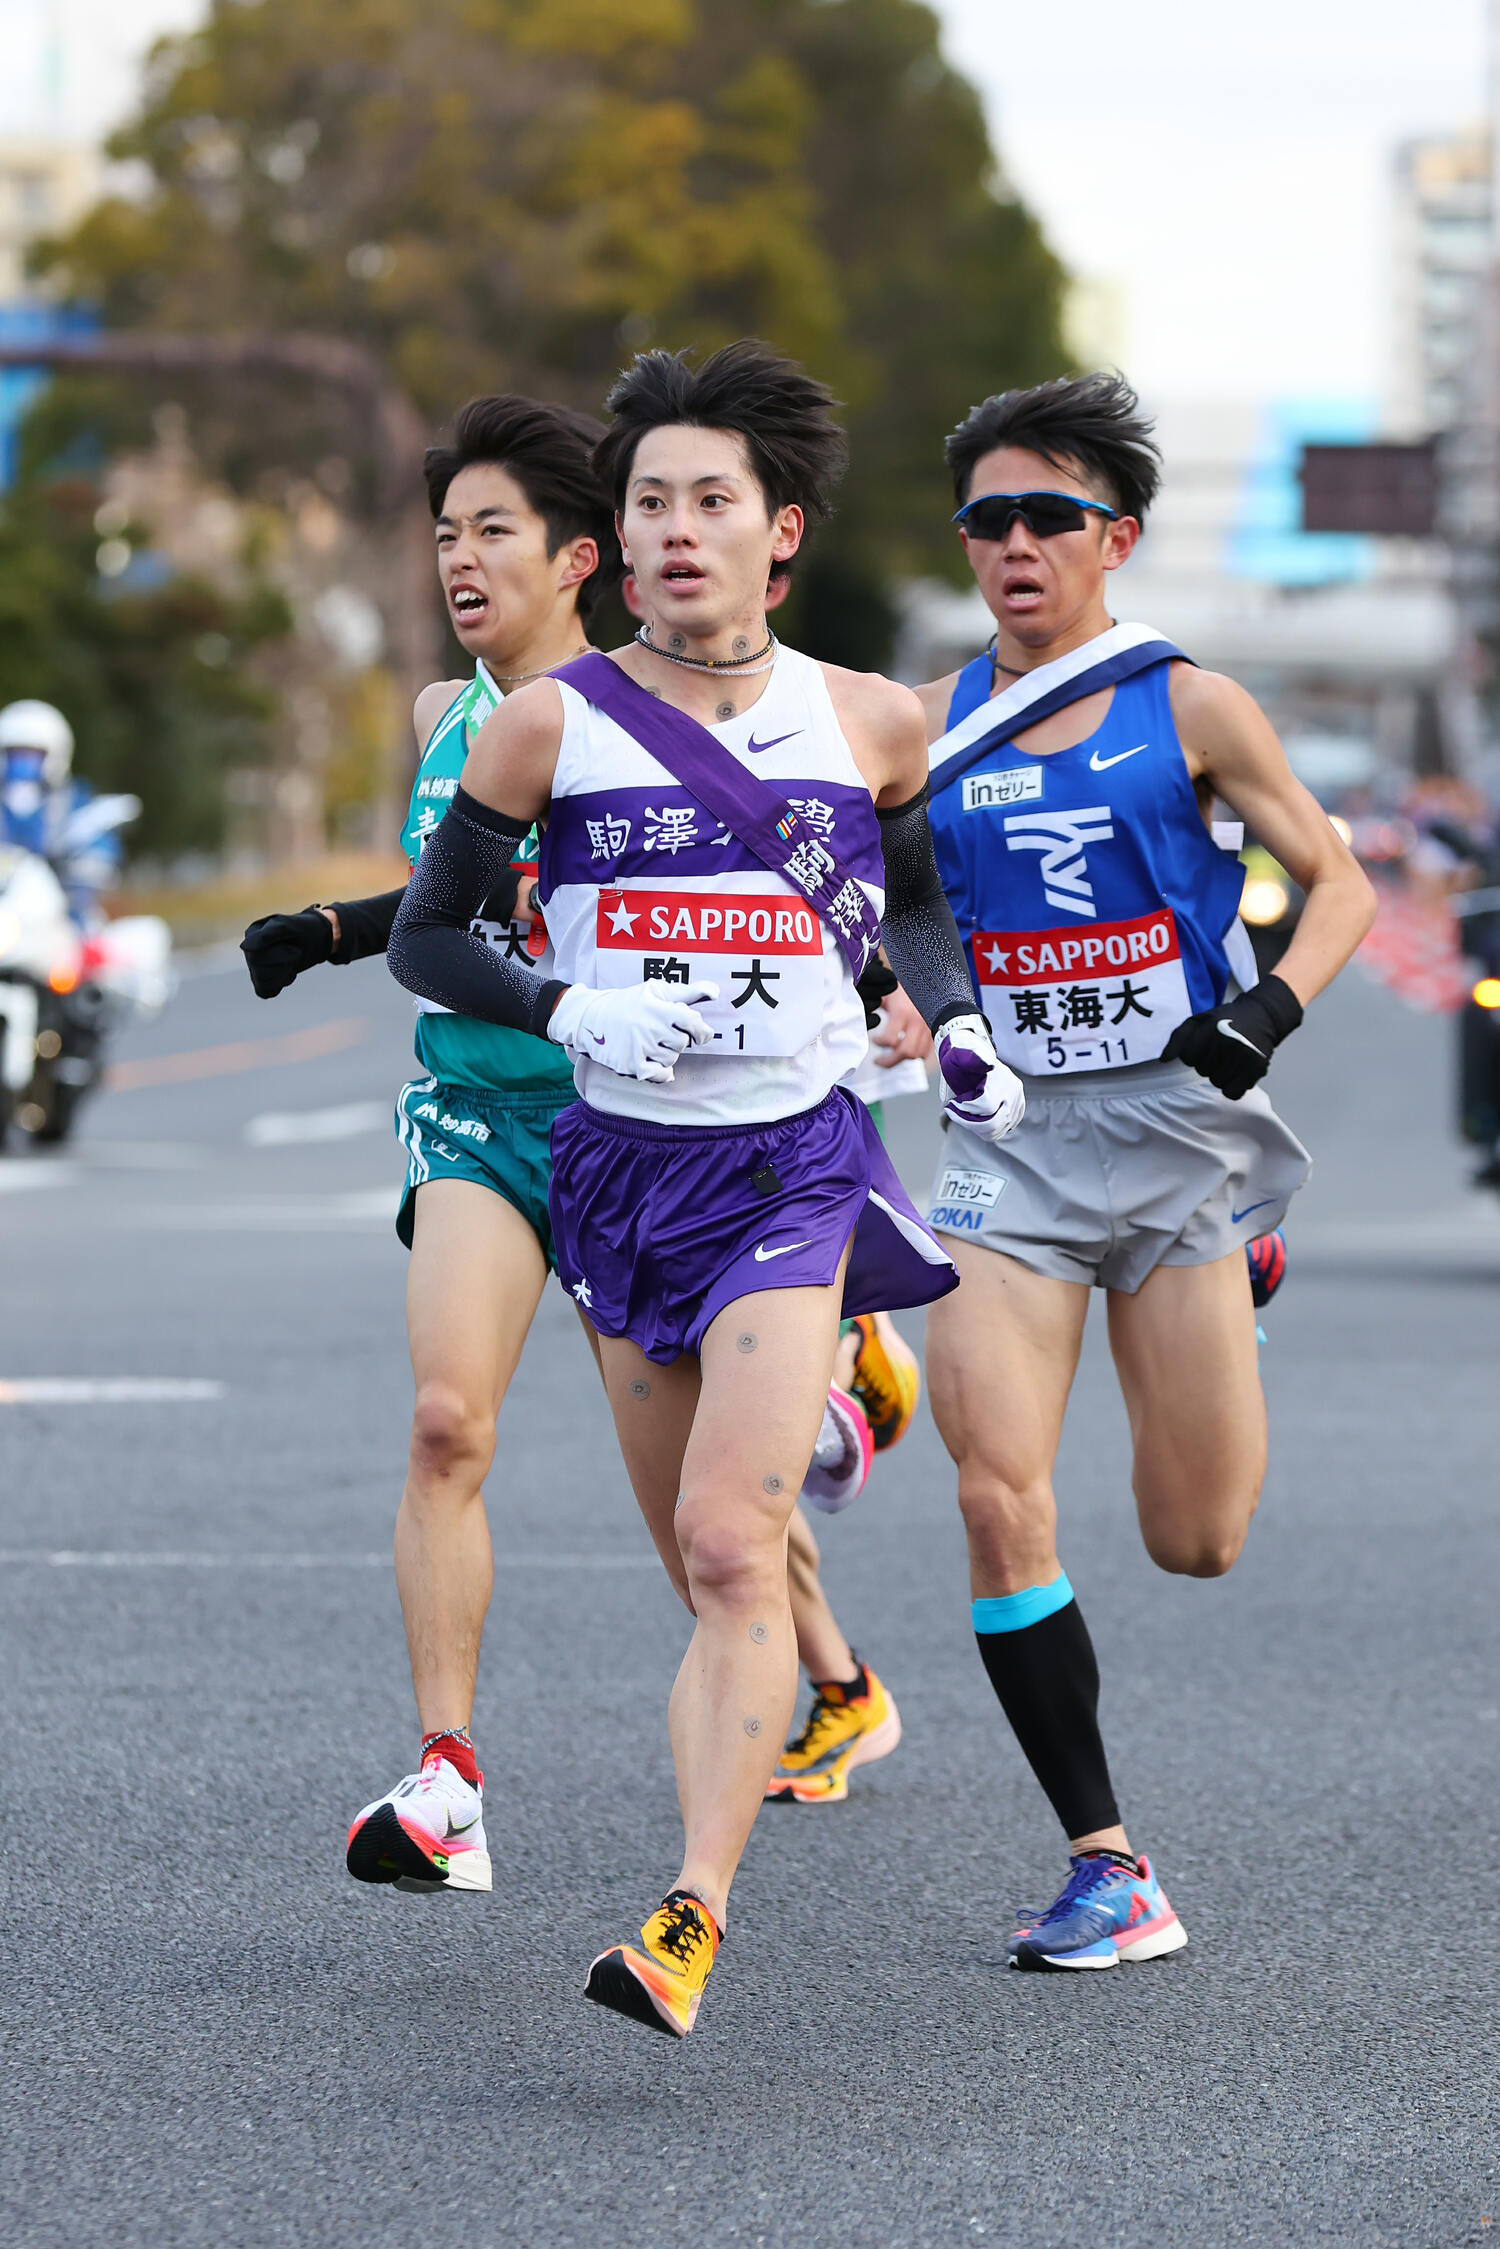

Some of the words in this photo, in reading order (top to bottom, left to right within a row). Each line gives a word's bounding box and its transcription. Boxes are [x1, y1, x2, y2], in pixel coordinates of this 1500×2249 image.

[649, 905, 814, 944] SAPPORO
[1016, 923, 1170, 976] SAPPORO
[1009, 978, 1154, 1035] 東海大
[1047, 1036, 1129, 1069] 5-11
